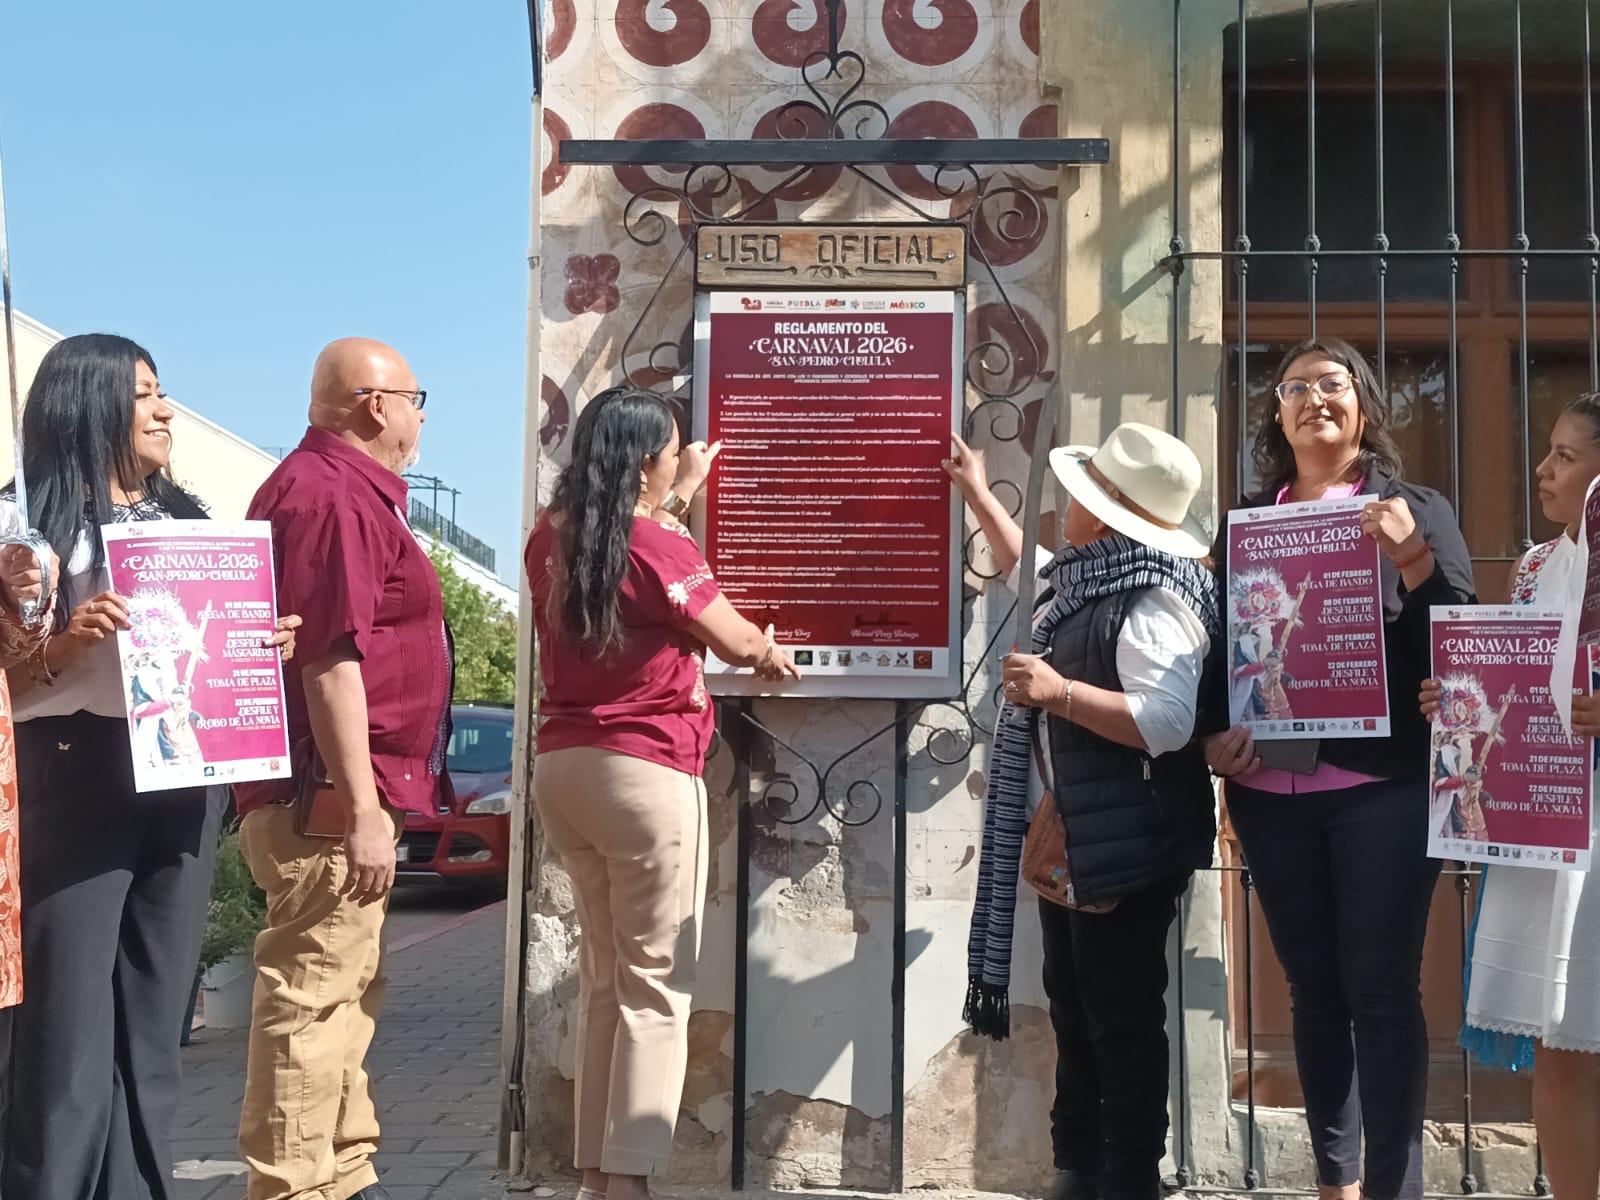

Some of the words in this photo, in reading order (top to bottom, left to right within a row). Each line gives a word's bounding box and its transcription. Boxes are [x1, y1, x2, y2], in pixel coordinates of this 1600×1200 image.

[716, 234, 782, 264] USO
[816, 234, 946, 265] OFICIAL
[774, 322, 862, 335] REGLAMENTO
[864, 322, 888, 335] DEL
[753, 337, 855, 354] CARNAVAL
[857, 337, 907, 354] 2026
[769, 355, 797, 367] SAN
[799, 355, 838, 367] PEDRO
[842, 355, 892, 367] CHOLULA
[1240, 531, 1320, 551] CARNAVAL
[1321, 525, 1361, 542] 2026
[1245, 549, 1271, 561] SAN
[1271, 547, 1308, 559] PEDRO
[126, 555, 218, 570] CARNAVAL
[219, 554, 259, 569] 2026
[134, 571, 163, 583] SAN
[166, 570, 205, 582] PEDRO
[1331, 571, 1341, 579] DE
[1325, 579, 1338, 588] DE
[1340, 577, 1373, 587] BANDO
[228, 609, 240, 619] DE
[1321, 605, 1359, 616] DESFILE
[1361, 604, 1374, 612] DE
[1344, 632, 1376, 641] FEBRERO
[1300, 643, 1328, 653] TOMA
[1331, 642, 1344, 651] DE
[1345, 641, 1376, 650] PLAZA
[1443, 638, 1526, 653] CARNAVAL
[1528, 638, 1560, 653] 202
[1336, 661, 1345, 669] DE
[1345, 660, 1378, 668] FEBRERO
[1448, 654, 1471, 665] SAN
[1471, 654, 1512, 665] PEDRO
[1331, 668, 1370, 678] DESFILE
[1371, 667, 1378, 676] Y
[206, 678, 235, 689] TOMA
[237, 677, 250, 687] DE
[250, 676, 277, 686] PLAZA
[1288, 679, 1319, 690] ROBO
[1320, 679, 1333, 688] DE
[1335, 679, 1348, 687] LA
[1349, 678, 1379, 687] NOVIA
[1532, 694, 1546, 704] DE
[272, 705, 279, 715] Y
[196, 718, 227, 730] ROBO
[229, 718, 242, 727] DE
[242, 717, 254, 726] LA
[1539, 716, 1550, 724] DE
[1529, 755, 1538, 763] 21
[1538, 755, 1548, 763] DE
[1549, 756, 1584, 765] FEBRERO
[1500, 762, 1532, 773] TOMA
[1533, 764, 1547, 773] DE
[1549, 765, 1584, 775] PLAZA
[1528, 785, 1538, 793] 22
[1538, 785, 1548, 793] DE
[1549, 785, 1584, 795] FEBRERO
[1531, 793, 1574, 804] DESFILE
[1576, 795, 1583, 805] Y
[1486, 801, 1518, 812] ROBO
[1519, 801, 1533, 812] DE
[1535, 804, 1549, 813] LA
[1551, 805, 1583, 815] NOVIA
